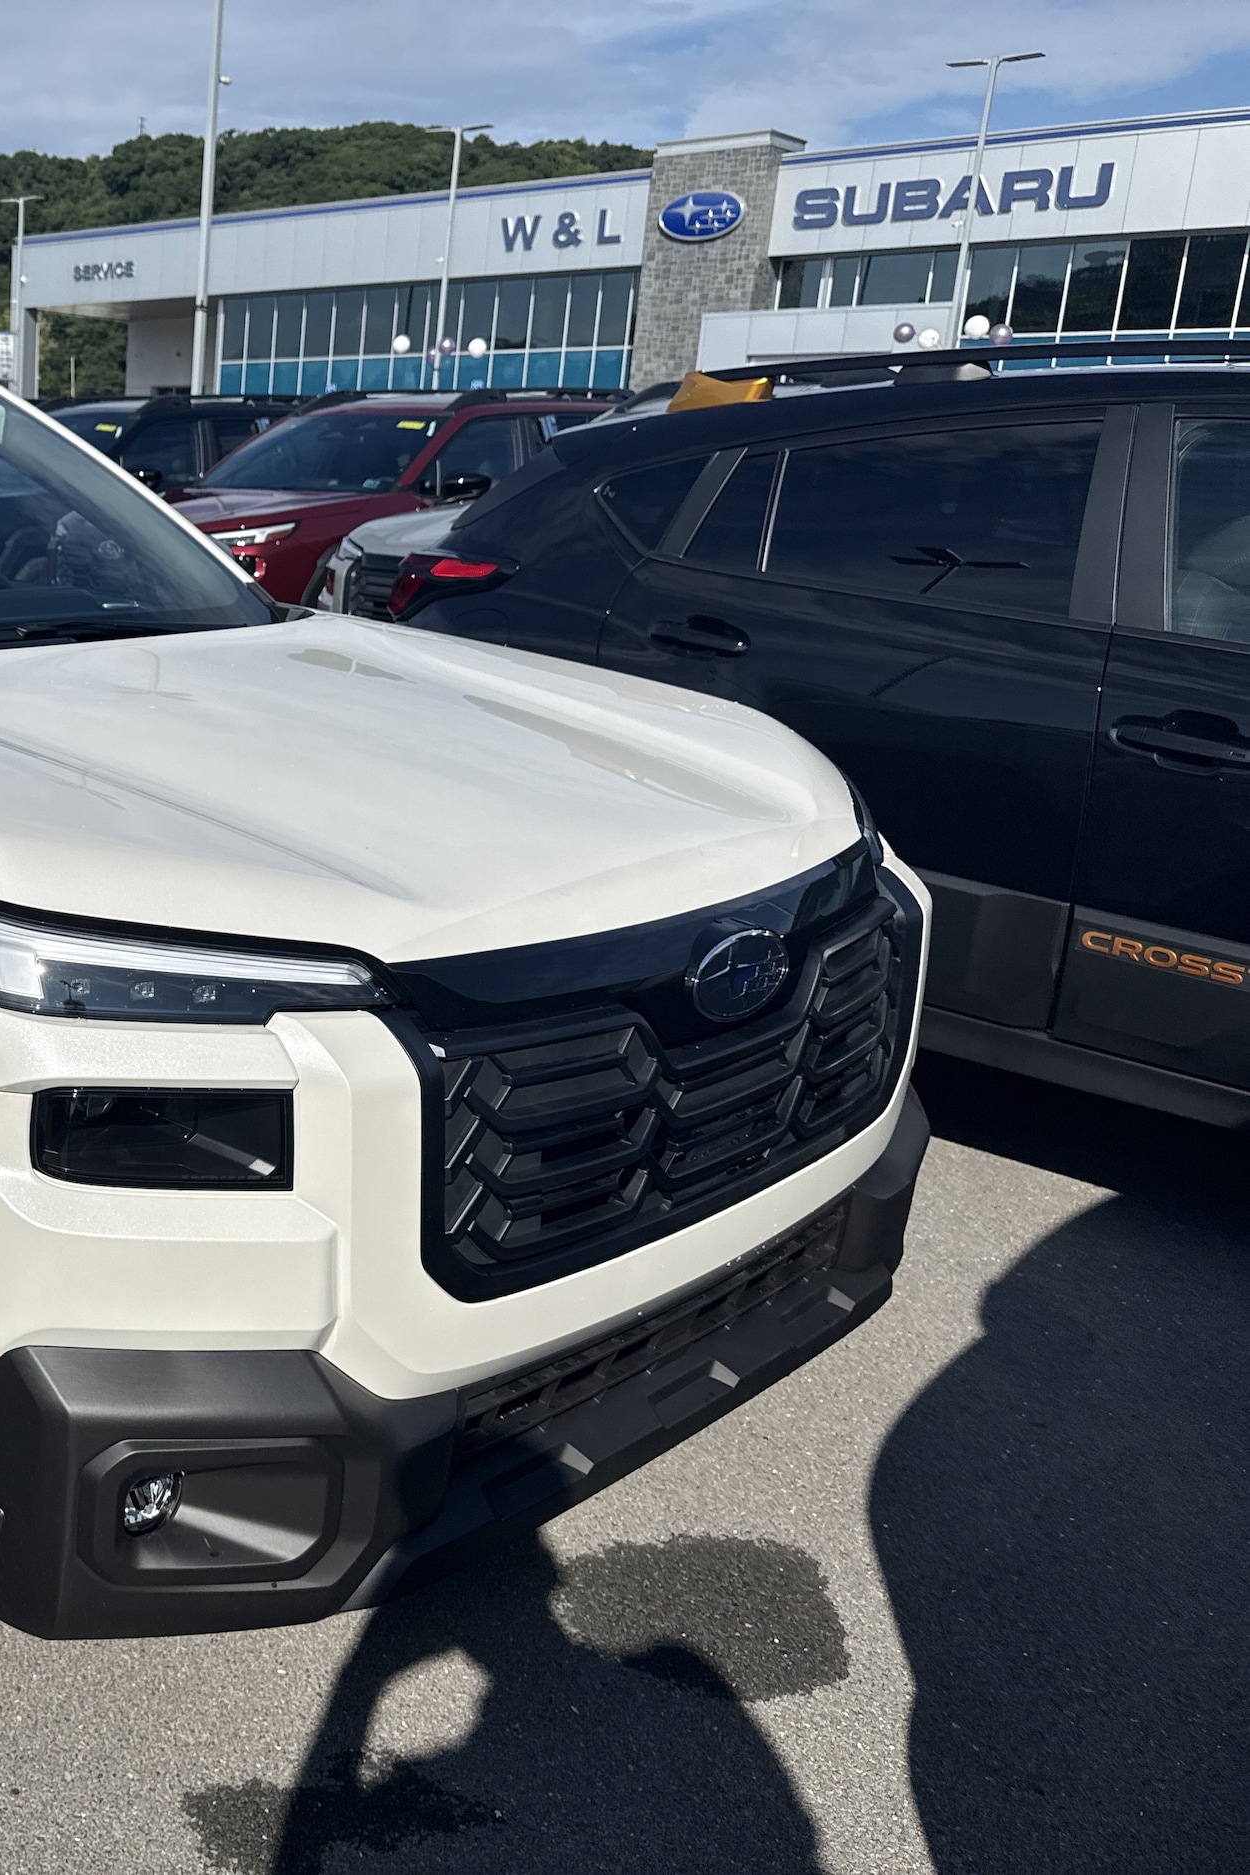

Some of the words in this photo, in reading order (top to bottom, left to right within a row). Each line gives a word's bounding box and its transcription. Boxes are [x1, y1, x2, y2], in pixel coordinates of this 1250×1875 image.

[793, 162, 1115, 231] SUBARU
[501, 213, 542, 253] W
[552, 211, 582, 250] &
[596, 208, 621, 246] L
[73, 261, 134, 282] SERVICE
[1081, 930, 1250, 985] CROSS
